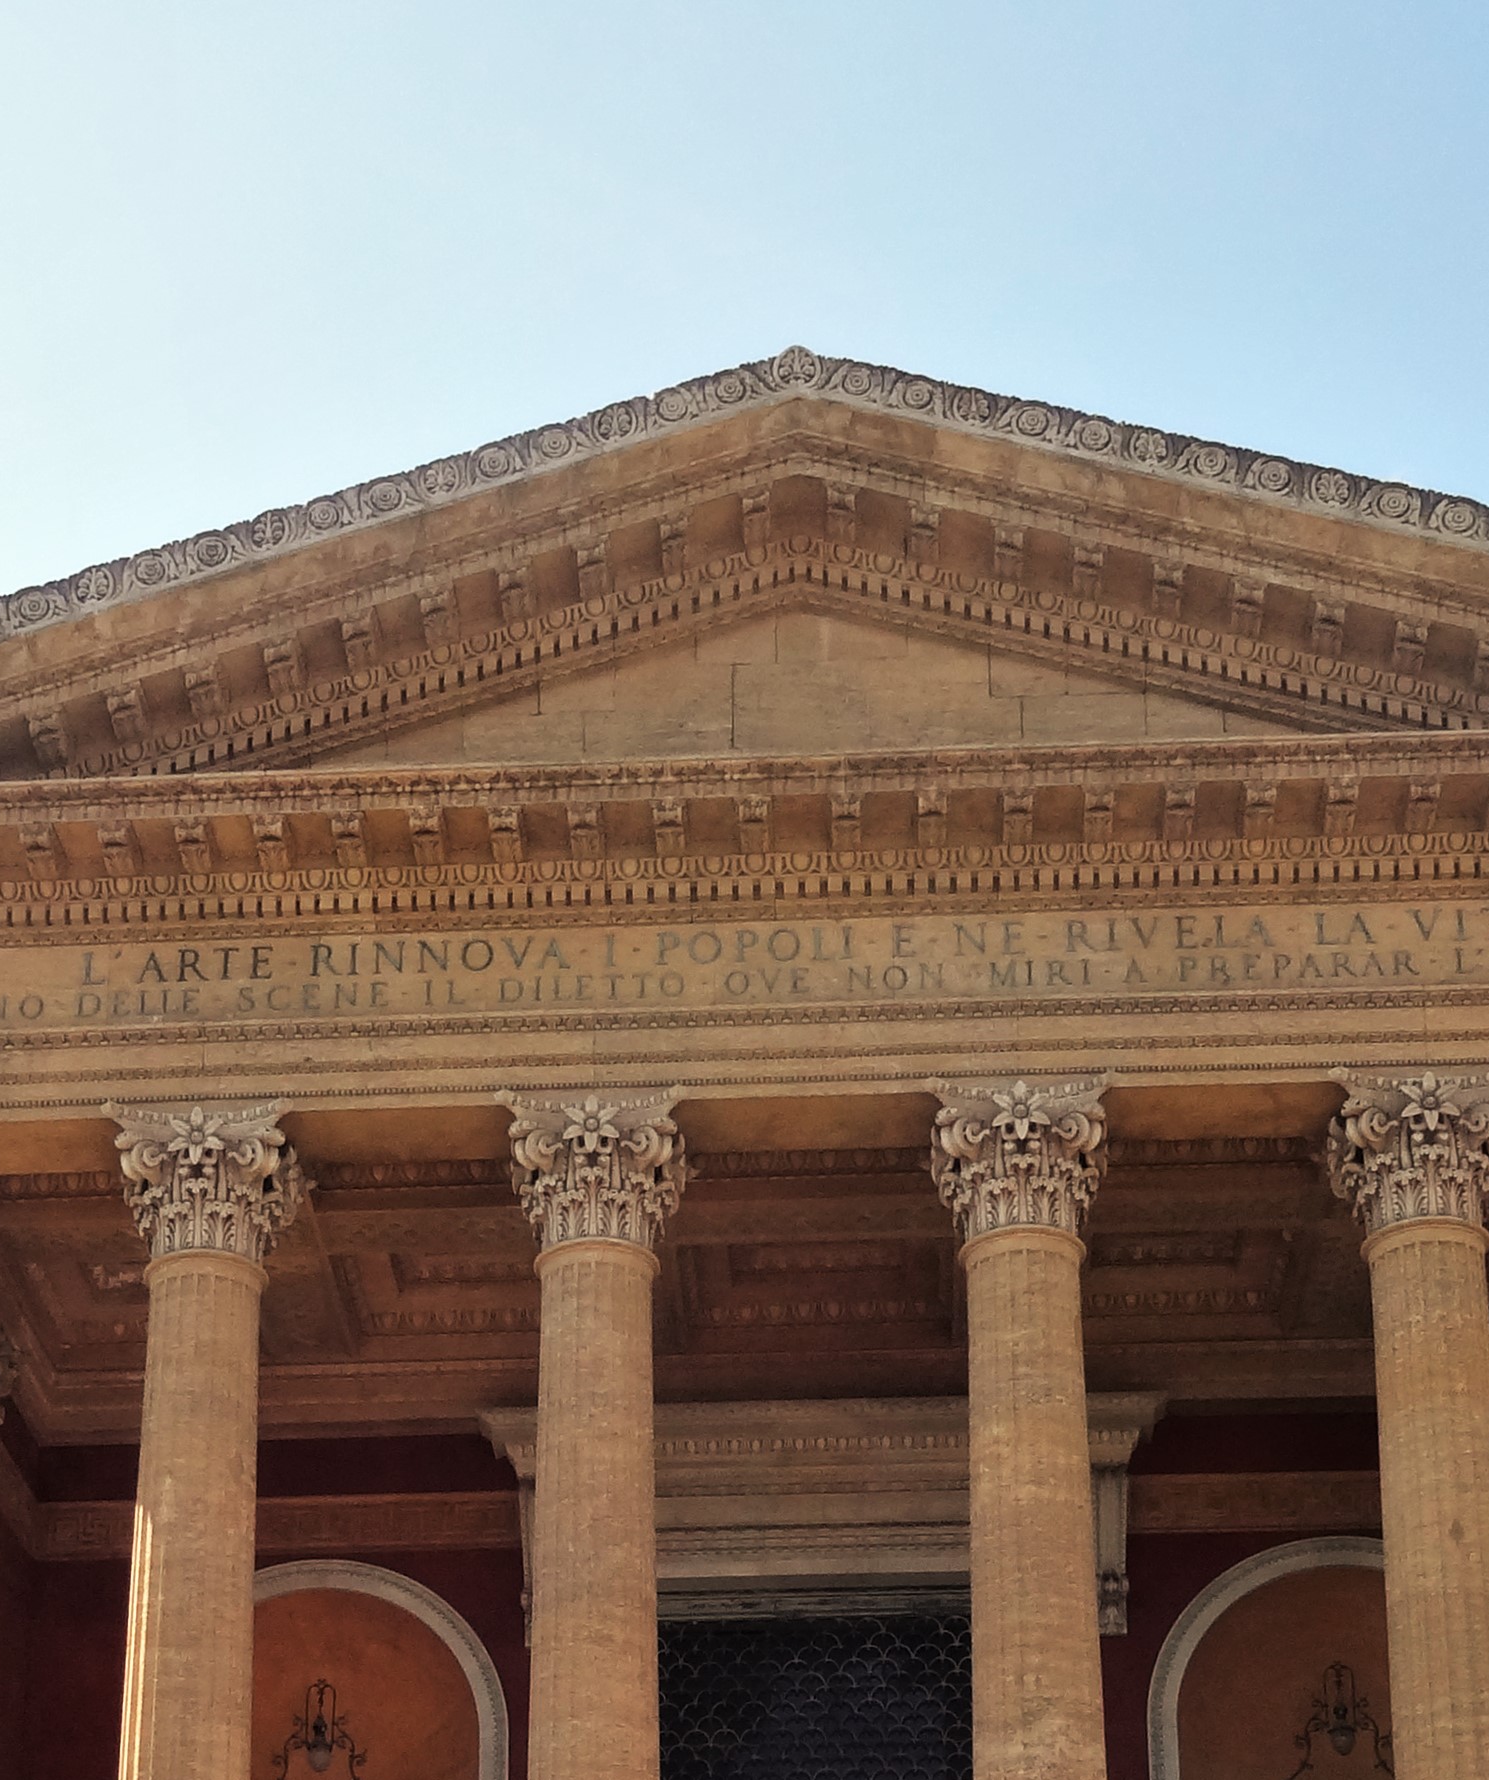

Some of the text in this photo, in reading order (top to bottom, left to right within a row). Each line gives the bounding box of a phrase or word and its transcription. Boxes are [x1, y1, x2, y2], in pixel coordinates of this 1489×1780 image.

[75, 987, 201, 1019] DELLE
[236, 981, 390, 1014] SCENE
[424, 978, 466, 1006] IL
[497, 970, 685, 1003] DILETTO
[724, 967, 811, 996] OVE
[848, 962, 944, 994] NON
[988, 957, 1092, 989] MIRI
[1122, 956, 1149, 984] A
[1178, 948, 1420, 984] PREPARAR
[82, 945, 275, 987] L'ARTE
[309, 935, 571, 978] RINNOVA
[604, 932, 617, 968] I
[654, 925, 854, 966] POPOLI
[892, 924, 916, 959] E
[952, 921, 1026, 957] NE
[1065, 914, 1275, 953] RIVELA
[1313, 910, 1377, 947] LA
